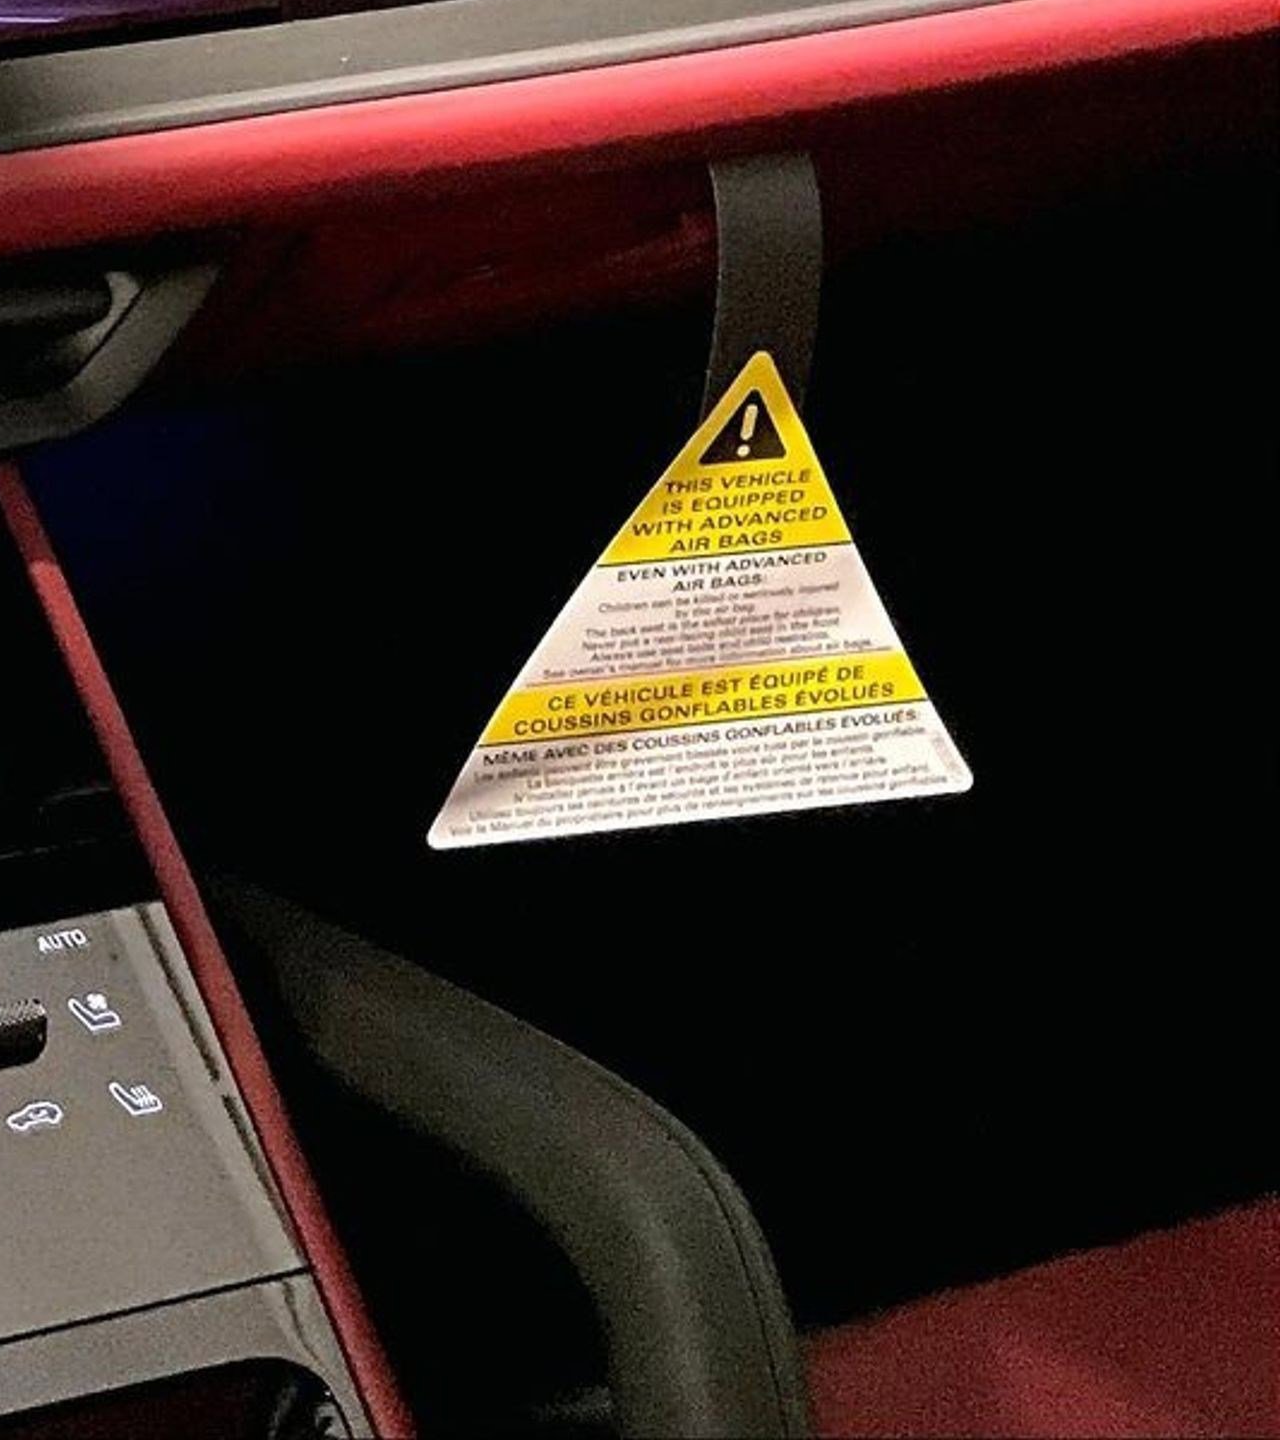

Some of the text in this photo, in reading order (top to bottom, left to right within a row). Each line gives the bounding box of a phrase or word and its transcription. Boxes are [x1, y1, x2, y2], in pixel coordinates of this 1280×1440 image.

[665, 469, 810, 494] THIS VEHICLE
[663, 490, 804, 515] IS EQUIPPED
[632, 506, 827, 537] WITH ADVANCED
[670, 530, 782, 553] AIR BAGS
[618, 552, 826, 582] EVEN WITH ADVANCED
[672, 578, 704, 592] AIR
[548, 665, 864, 711] CE VÉHICULE EST ÉQUIPÉ DE
[514, 682, 894, 736] COUSSINS GONFLABLES ÉVOLUÉS
[483, 750, 537, 767] MÊME
[544, 743, 590, 760] AVEC
[594, 740, 627, 756] DES
[632, 730, 720, 752] COUSSINS
[725, 718, 836, 742] GONFLABLES
[37, 928, 88, 953] AUTO
